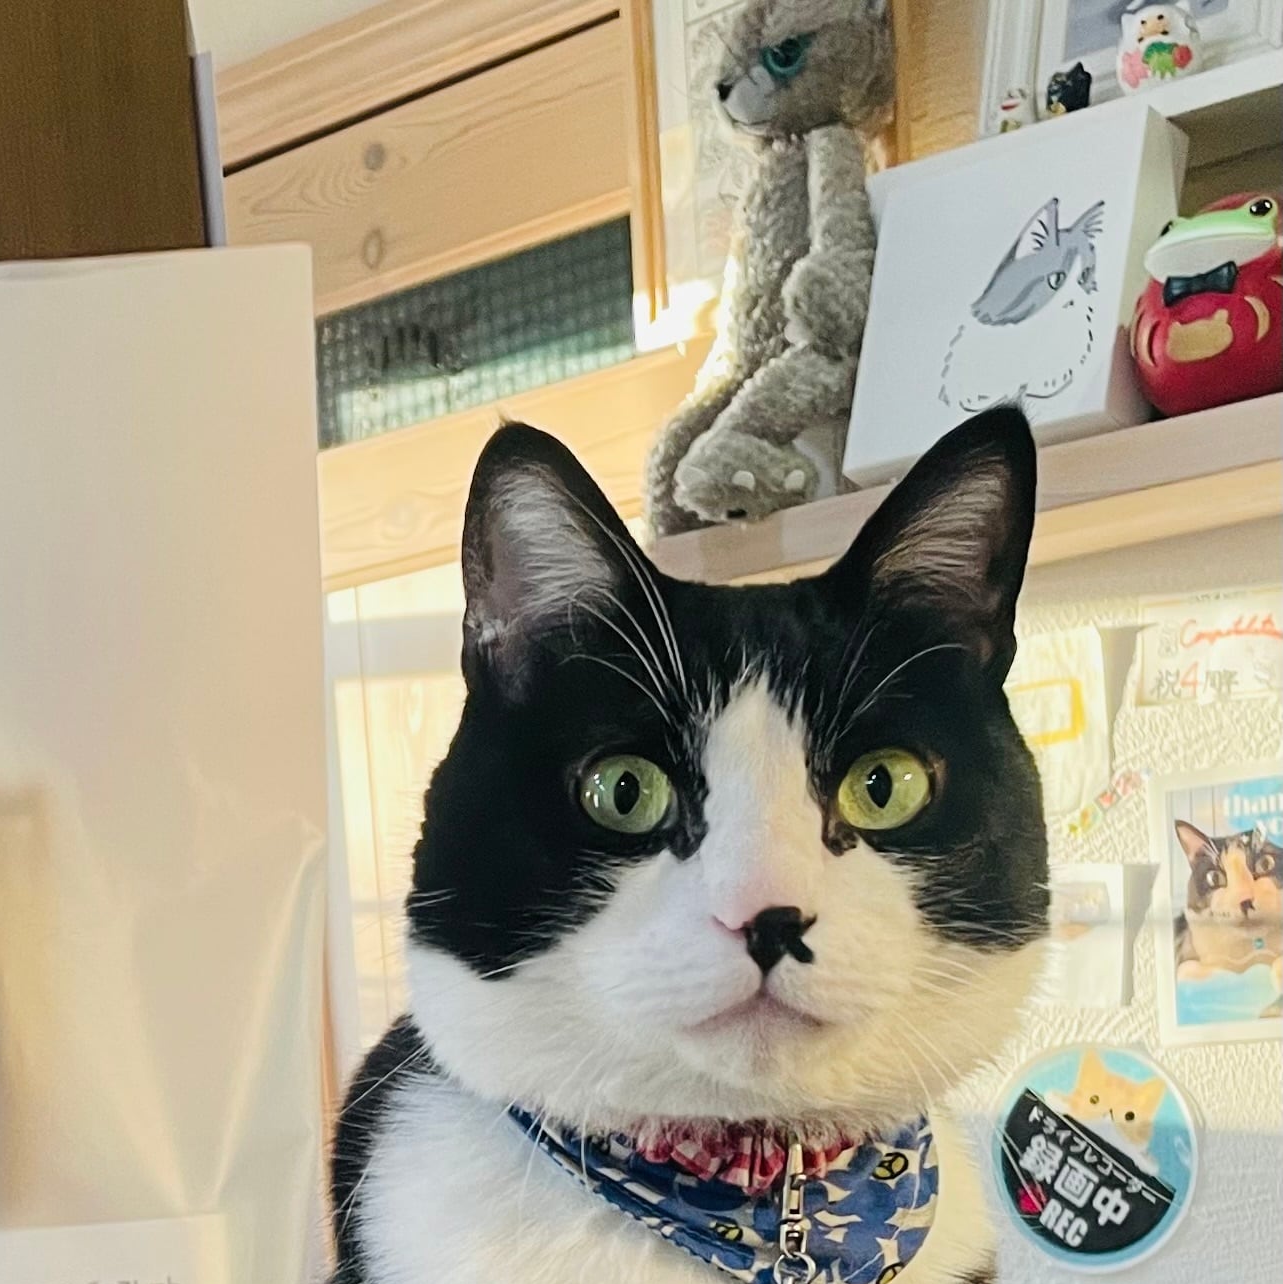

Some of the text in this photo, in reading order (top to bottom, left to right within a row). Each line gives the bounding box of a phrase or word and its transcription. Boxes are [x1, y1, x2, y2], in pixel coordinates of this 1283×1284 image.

[1018, 1133, 1131, 1227] 録画中
[1039, 1199, 1089, 1248] REC
